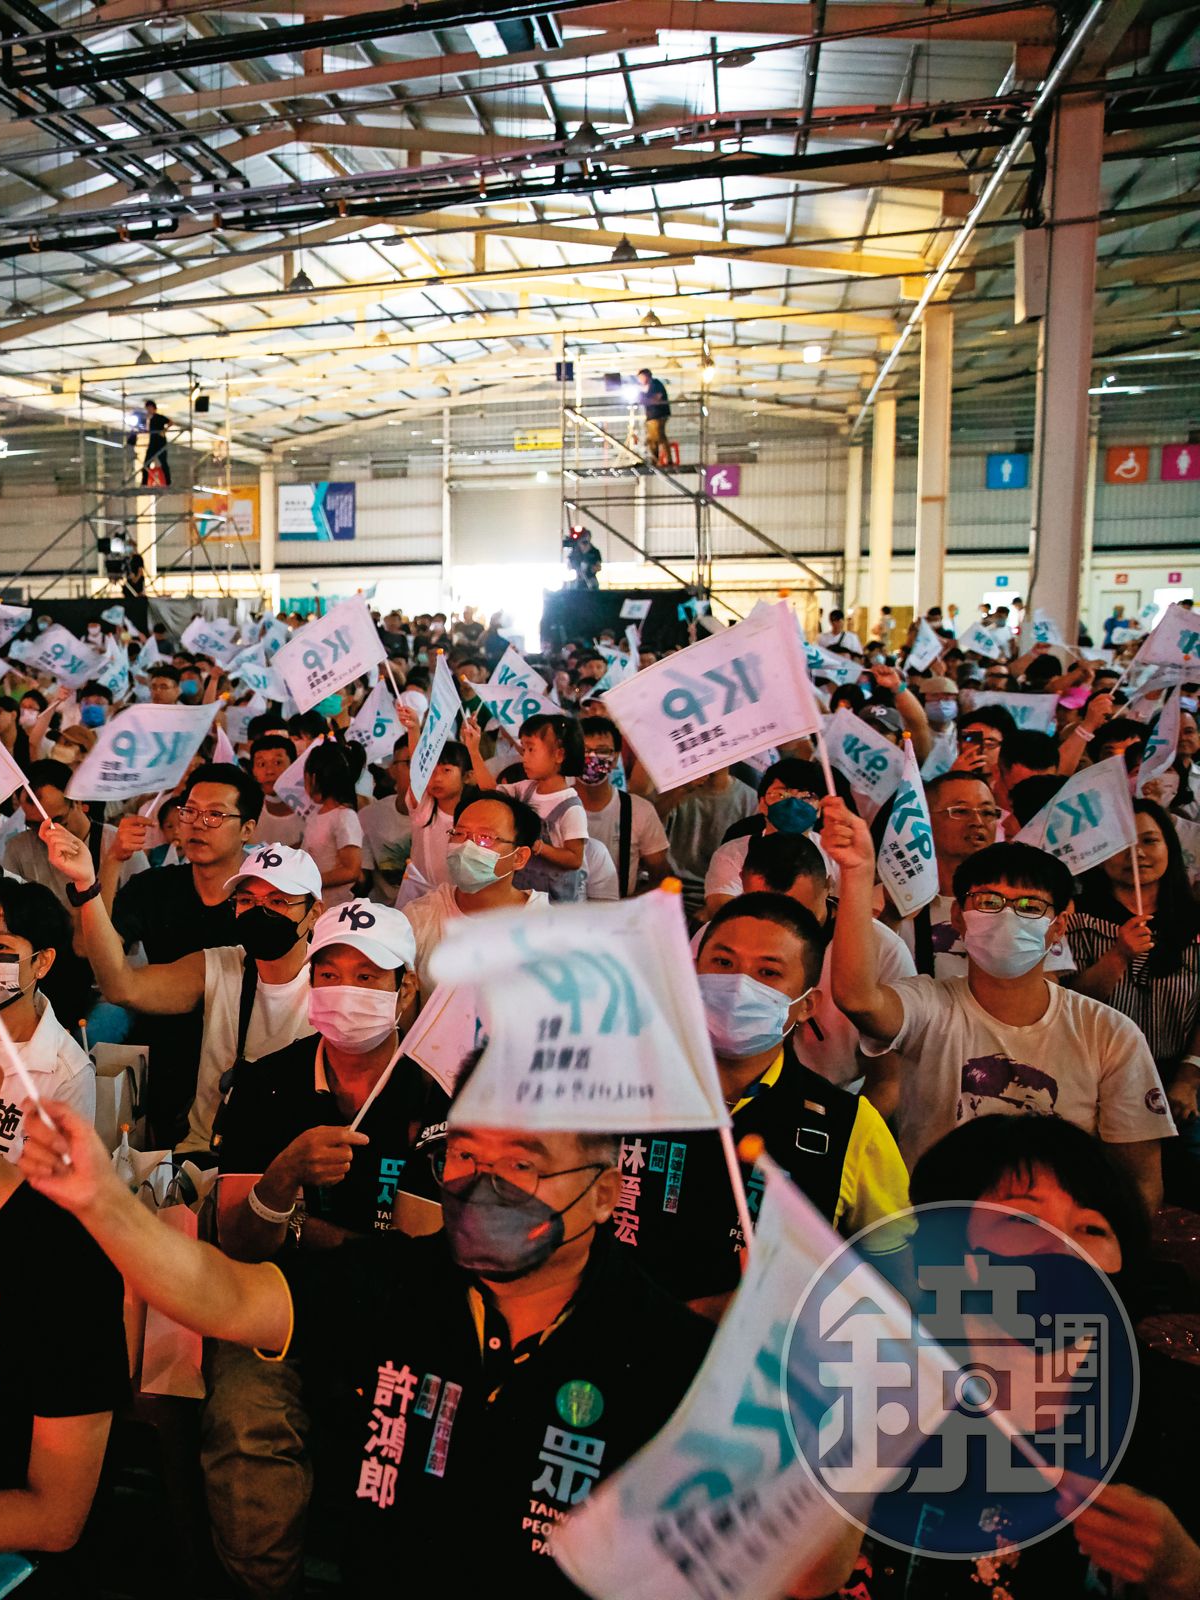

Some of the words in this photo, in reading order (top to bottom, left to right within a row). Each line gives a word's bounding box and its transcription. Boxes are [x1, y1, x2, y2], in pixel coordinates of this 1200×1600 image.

[842, 733, 889, 771] KP
[892, 786, 932, 860] KP
[256, 848, 283, 870] KP
[338, 904, 377, 932] KP
[356, 1360, 419, 1510] 許鴻郎
[529, 1499, 570, 1523] TAIW
